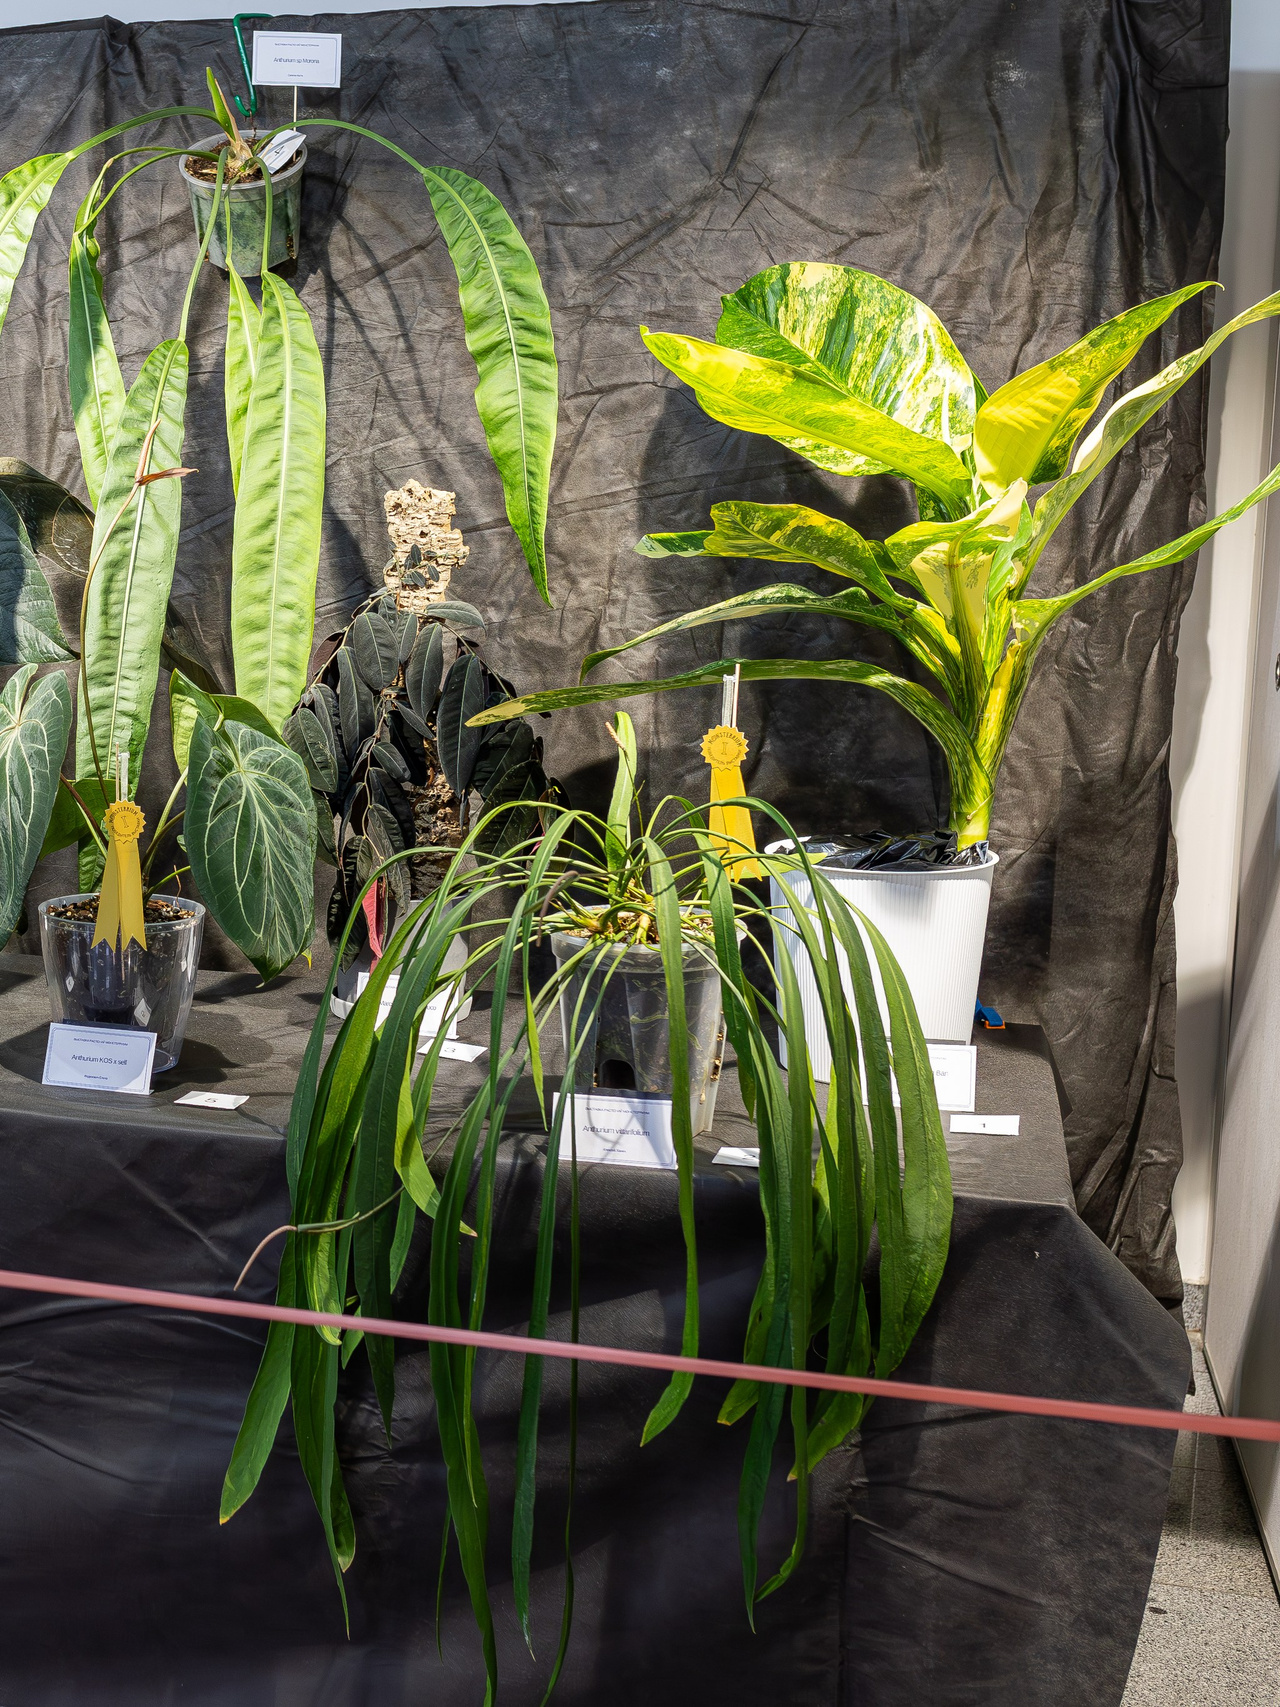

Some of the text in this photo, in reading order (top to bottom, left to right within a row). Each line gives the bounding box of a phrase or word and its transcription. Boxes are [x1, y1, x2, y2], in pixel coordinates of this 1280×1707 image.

[71, 1054, 99, 1063] Anthurium
[99, 1056, 113, 1064] KOS
[582, 1125, 615, 1134] Anthurium
